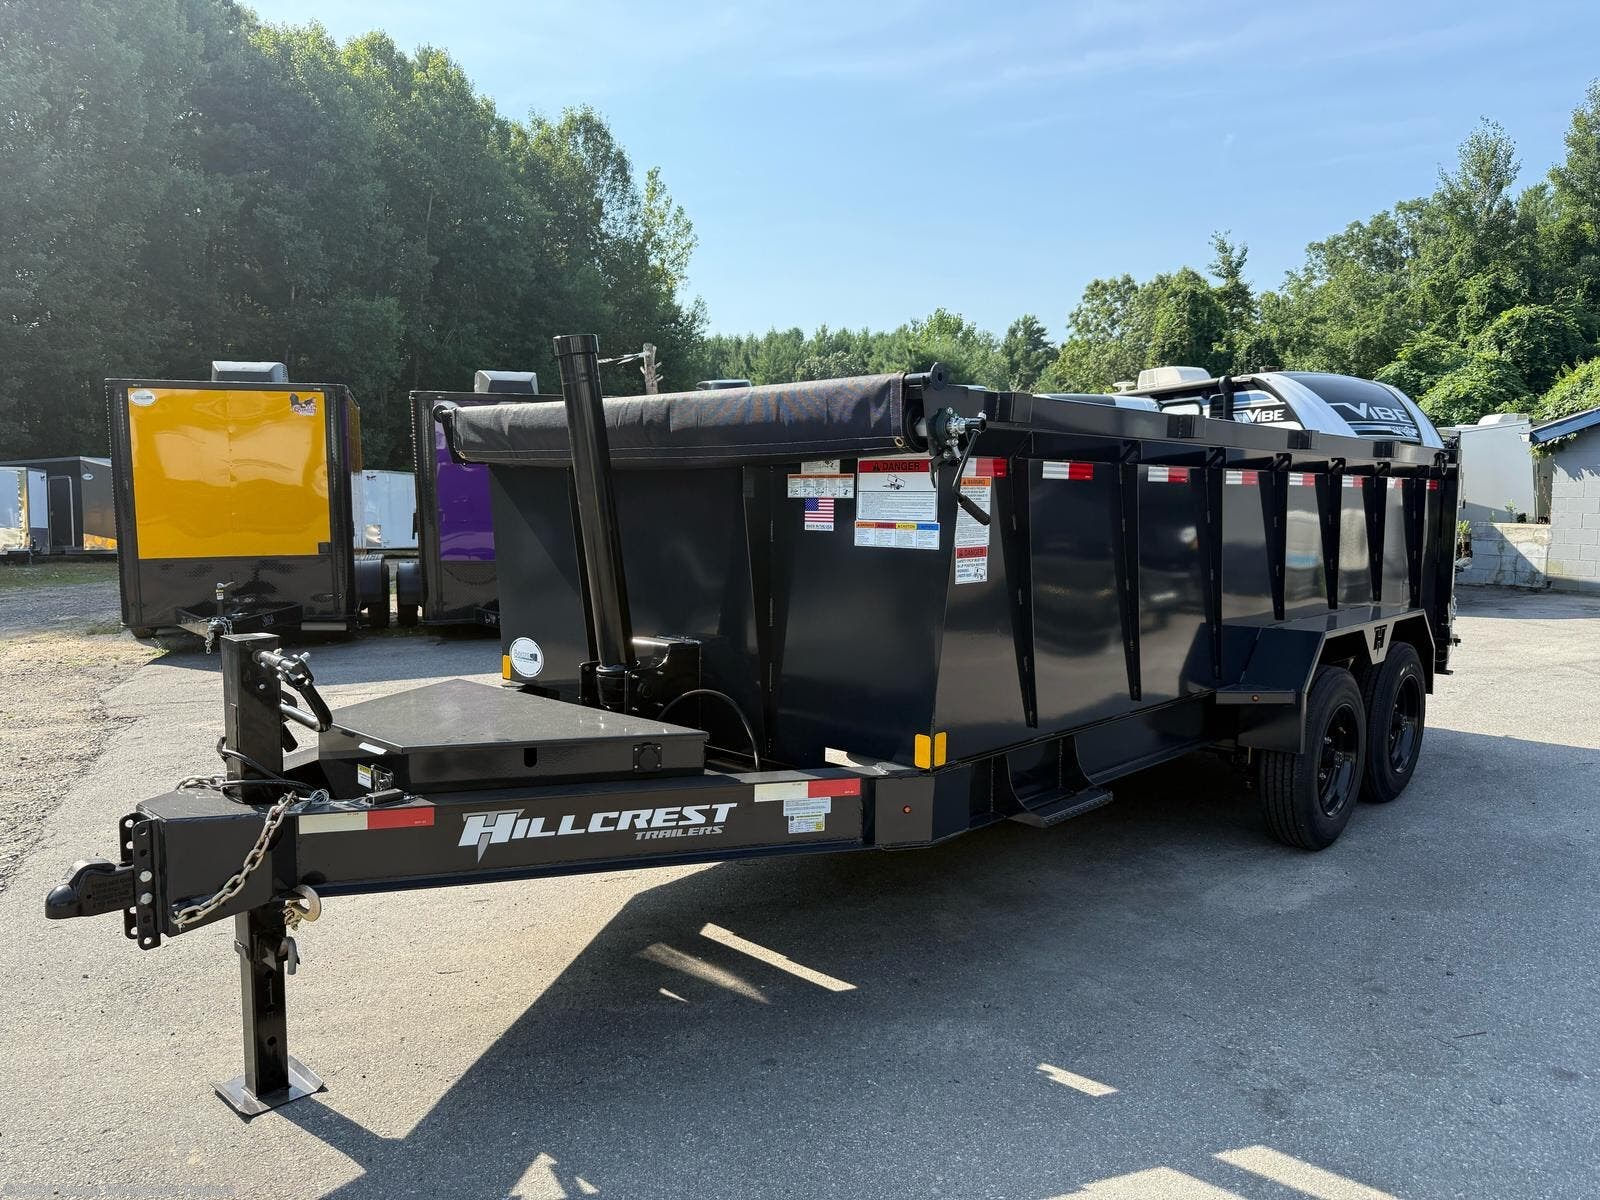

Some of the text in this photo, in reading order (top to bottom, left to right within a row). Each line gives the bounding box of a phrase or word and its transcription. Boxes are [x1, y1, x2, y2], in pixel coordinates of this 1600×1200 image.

[1246, 408, 1285, 423] VIBE
[1344, 403, 1412, 423] VIBE
[882, 461, 920, 471] DANGER
[458, 802, 738, 850] HILLCREST
[634, 825, 725, 841] TRAILERS
